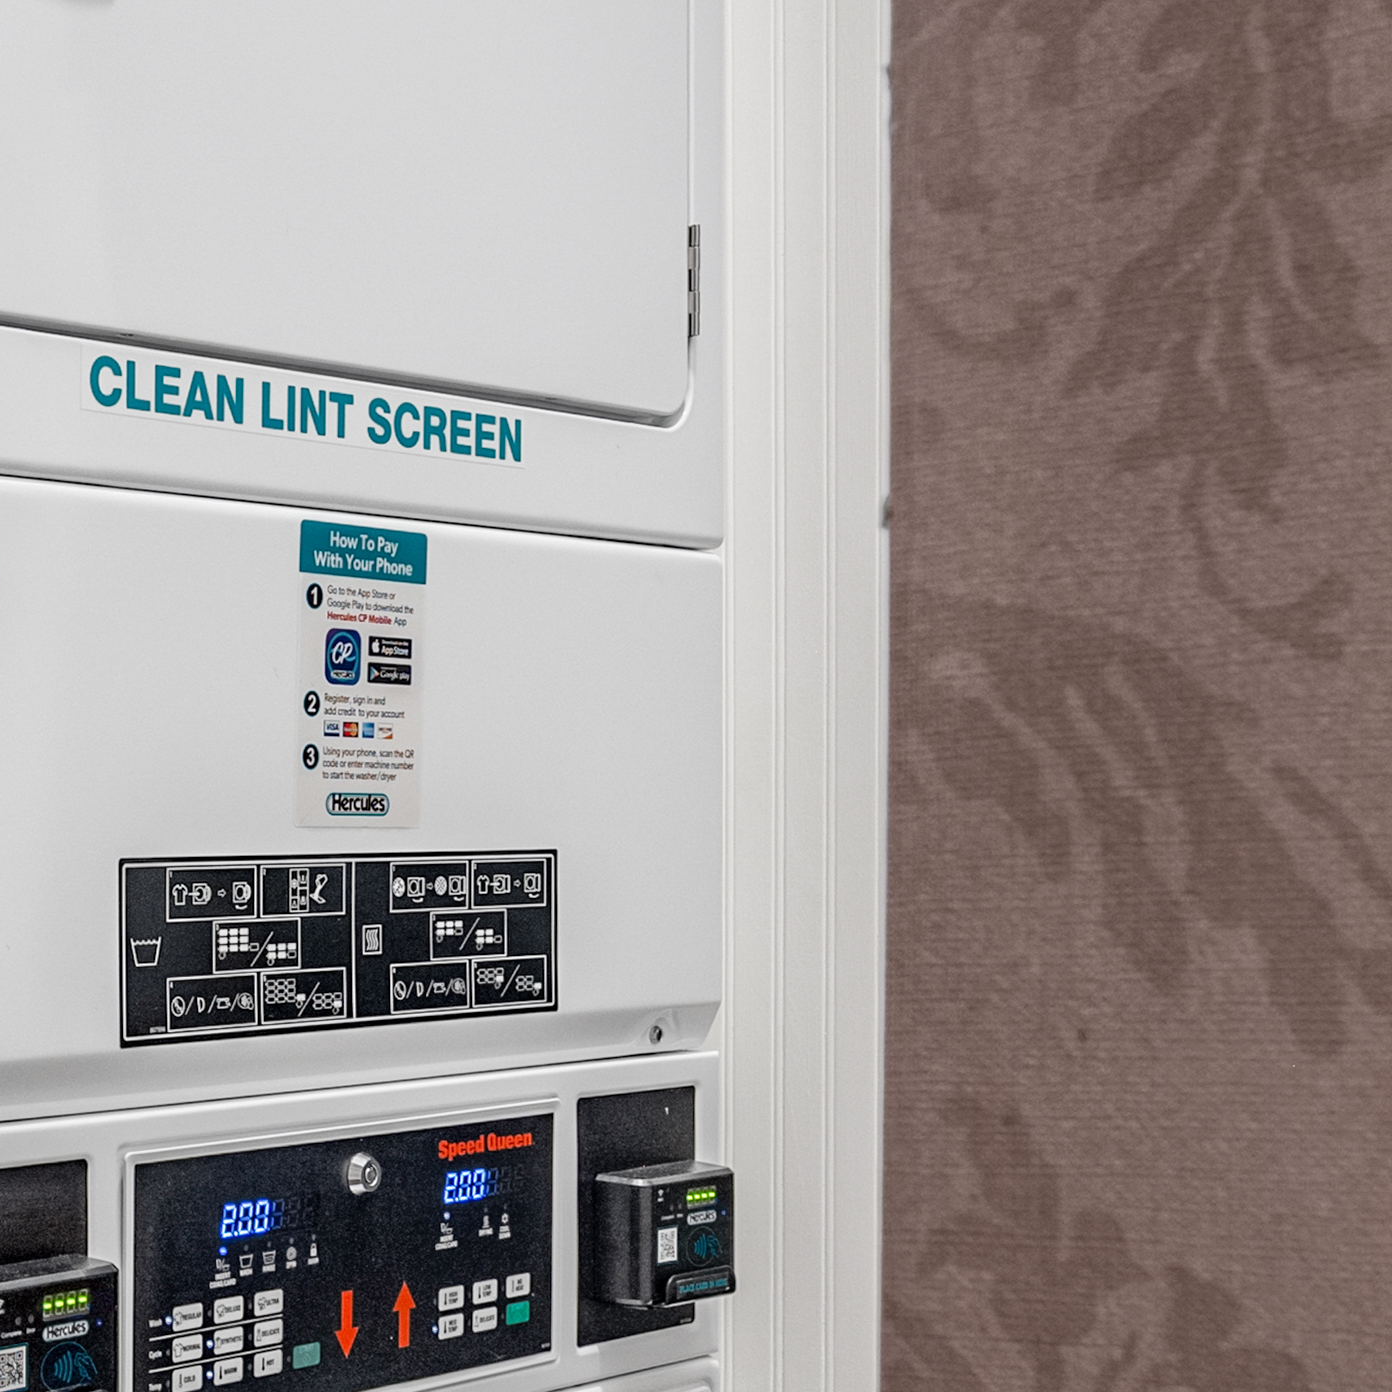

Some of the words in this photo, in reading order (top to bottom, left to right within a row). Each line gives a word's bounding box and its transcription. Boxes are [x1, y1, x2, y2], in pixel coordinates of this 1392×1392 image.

[89, 354, 244, 425] CLEAN
[261, 381, 354, 439] LINT
[366, 397, 522, 463] SCREEN
[330, 531, 358, 550] How
[360, 534, 375, 551] To
[377, 536, 398, 557] Pay
[313, 550, 343, 569] With
[345, 553, 374, 573] Your
[376, 557, 413, 576] Phone
[310, 586, 318, 606] 1
[327, 585, 337, 594] Go
[338, 587, 345, 595] to
[346, 587, 356, 596] the
[357, 589, 370, 598] App
[372, 589, 388, 599] Store
[327, 598, 350, 610] Google
[352, 600, 364, 611] Play
[365, 602, 372, 610] to
[373, 603, 403, 613] download
[404, 606, 413, 614] the
[327, 611, 357, 622] Hercules
[358, 613, 367, 622] CP
[369, 614, 392, 625] Mobile
[393, 617, 407, 626] App
[307, 694, 317, 713] 2
[353, 695, 365, 706] sign
[367, 695, 373, 703] in
[374, 696, 385, 705] and
[324, 707, 336, 715] add
[338, 707, 356, 716] credit
[366, 710, 379, 719] your
[306, 747, 316, 766] 3
[323, 746, 340, 757] Using
[342, 749, 355, 758] your
[379, 749, 392, 757] scan
[394, 749, 403, 758] the
[405, 749, 414, 758] QR
[322, 759, 338, 768] code
[364, 760, 389, 769] machine
[391, 761, 414, 770] number
[322, 771, 329, 779] to
[330, 771, 343, 779] start
[345, 771, 354, 779] the
[332, 794, 385, 812] Hercules
[438, 1134, 485, 1161] Speed
[487, 1132, 532, 1151] Queen
[444, 1168, 487, 1204] 2.00
[221, 1198, 270, 1238] 2.00
[47, 1321, 86, 1340] Hercules
